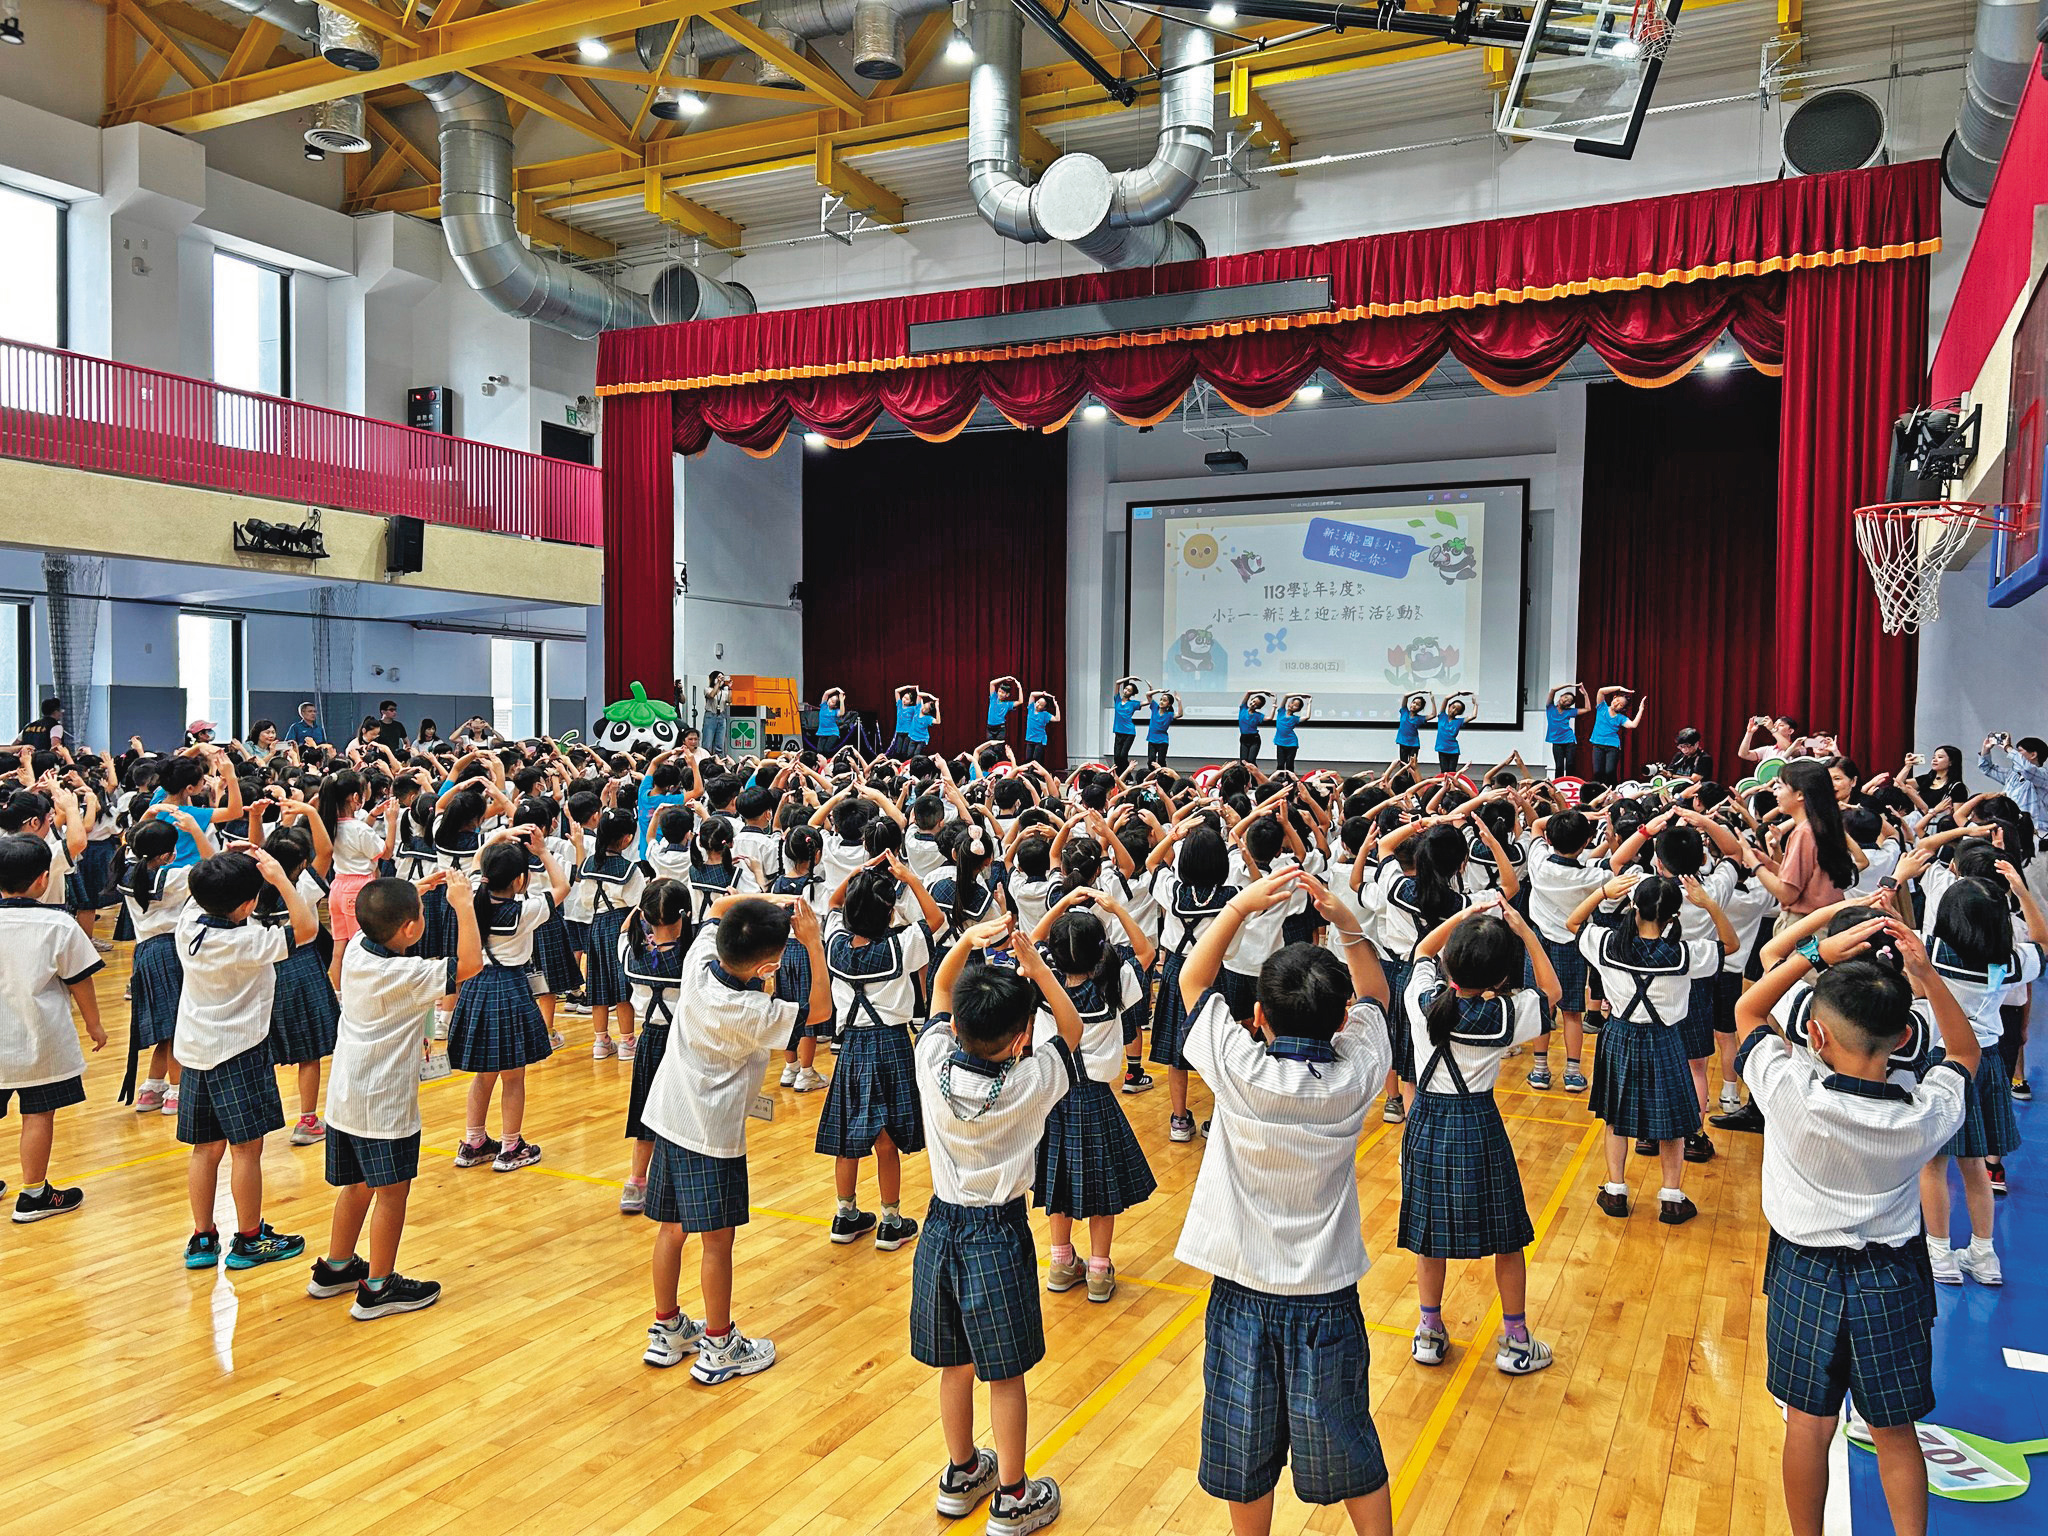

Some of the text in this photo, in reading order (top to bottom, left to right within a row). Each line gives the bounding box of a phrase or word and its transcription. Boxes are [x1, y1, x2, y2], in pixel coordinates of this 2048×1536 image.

[1323, 527, 1401, 552] 新埔國小
[1328, 545, 1386, 566] 歡迎你
[1263, 580, 1364, 600] 113學年度
[1212, 604, 1422, 623] 小一新生迎新活動
